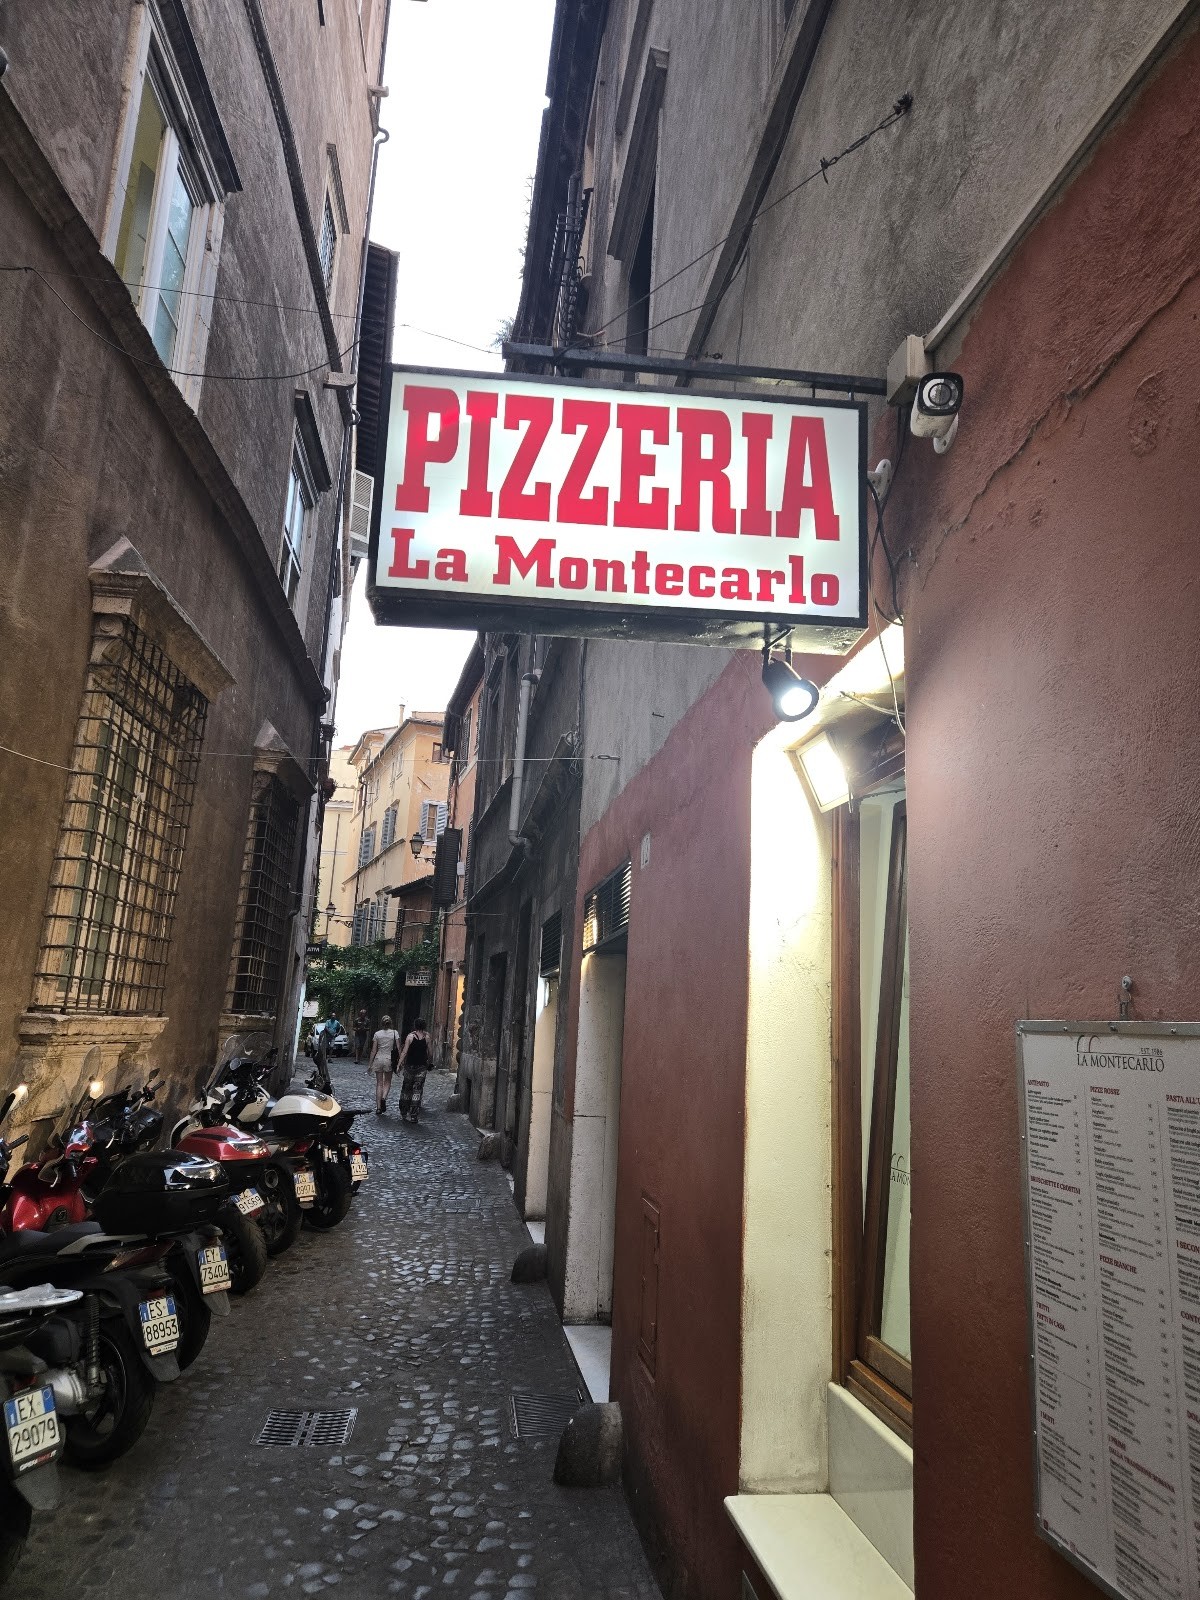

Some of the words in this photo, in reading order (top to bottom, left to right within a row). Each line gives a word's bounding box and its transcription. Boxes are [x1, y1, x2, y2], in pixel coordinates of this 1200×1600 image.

[395, 385, 840, 541] PIZZERIA
[388, 527, 468, 583] La
[493, 535, 840, 607] Montecarlo
[1077, 1054, 1088, 1067] LA
[1090, 1054, 1165, 1072] MONTECARLO
[1090, 1085, 1103, 1094] PIZZE
[1166, 1094, 1184, 1104] PASTA
[205, 1248, 215, 1264] EY
[202, 1263, 228, 1282] 73404
[1113, 1259, 1137, 1274] BIANCHE
[148, 1301, 163, 1319] ES
[145, 1319, 178, 1342] 88953
[17, 1394, 37, 1421] EX
[12, 1417, 57, 1456] 29079
